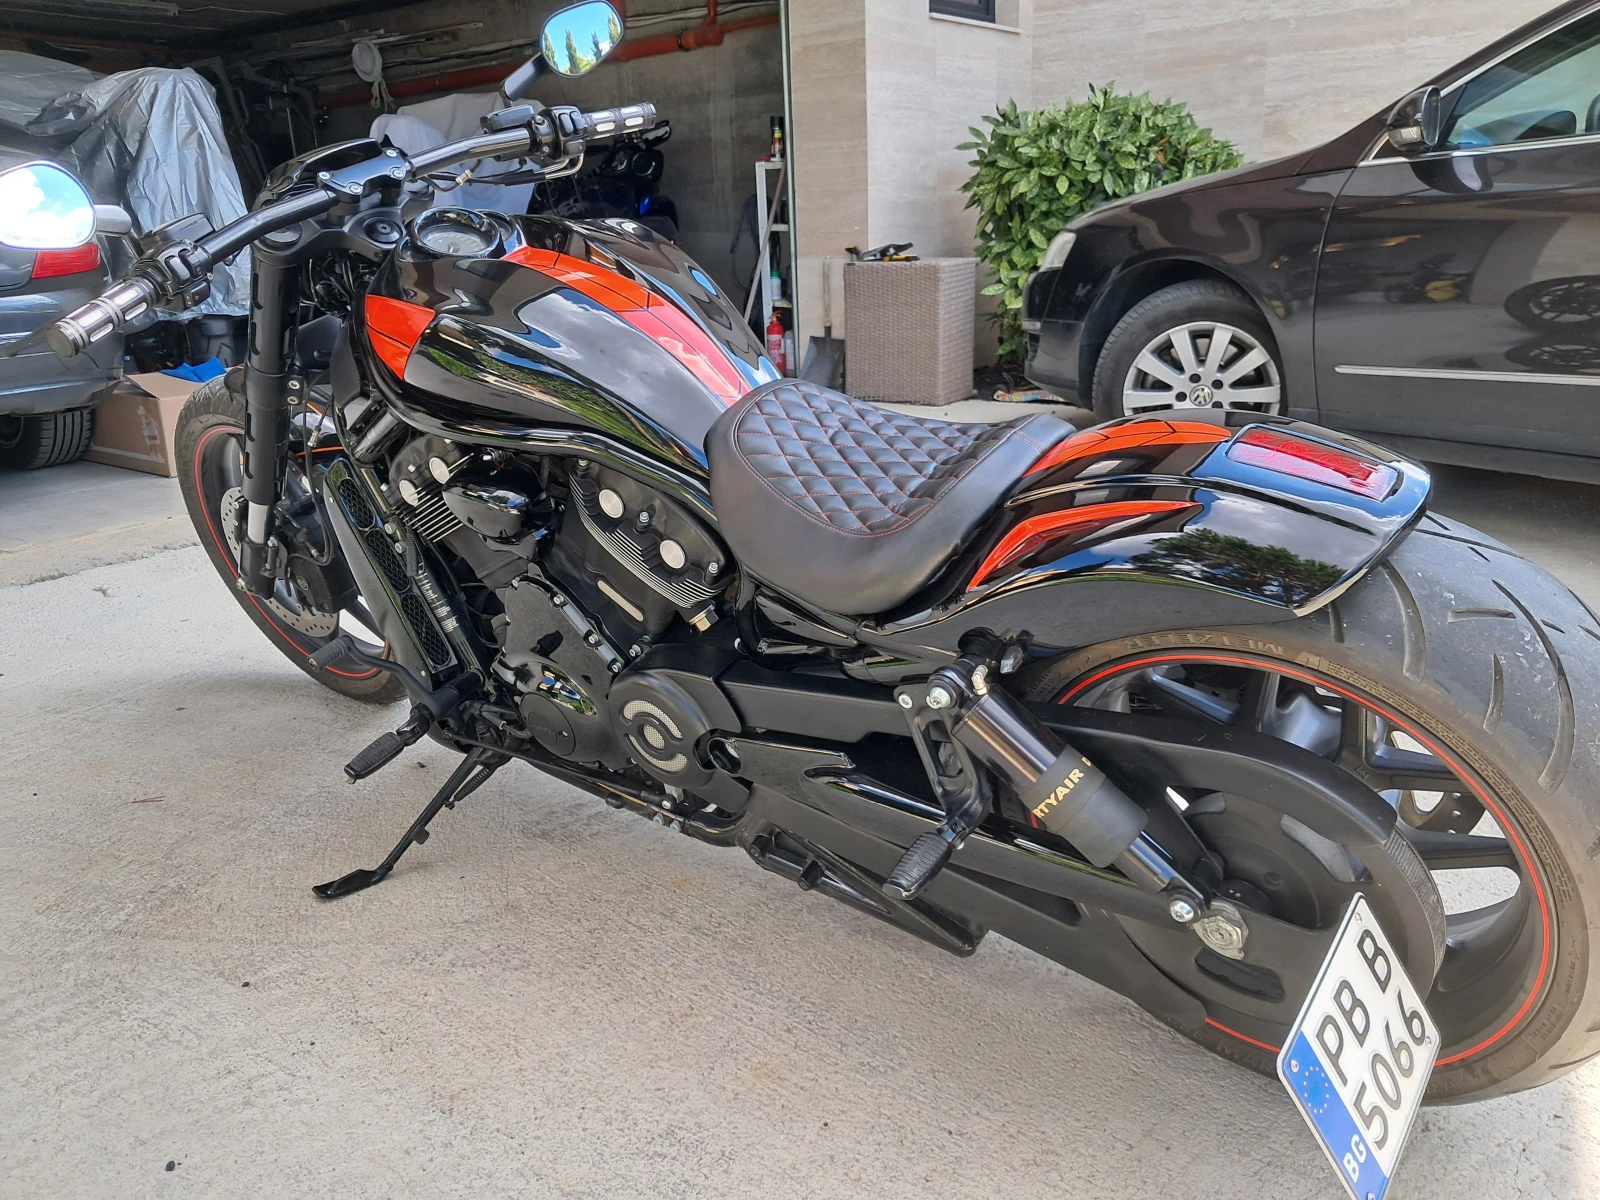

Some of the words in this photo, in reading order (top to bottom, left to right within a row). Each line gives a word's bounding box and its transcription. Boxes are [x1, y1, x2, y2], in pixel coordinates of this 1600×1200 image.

[1125, 632, 1286, 657] METZELER
[1317, 980, 1370, 1087] PB
[1356, 929, 1392, 993] B
[1353, 988, 1426, 1150] 5066
[1343, 1134, 1367, 1183] BG
